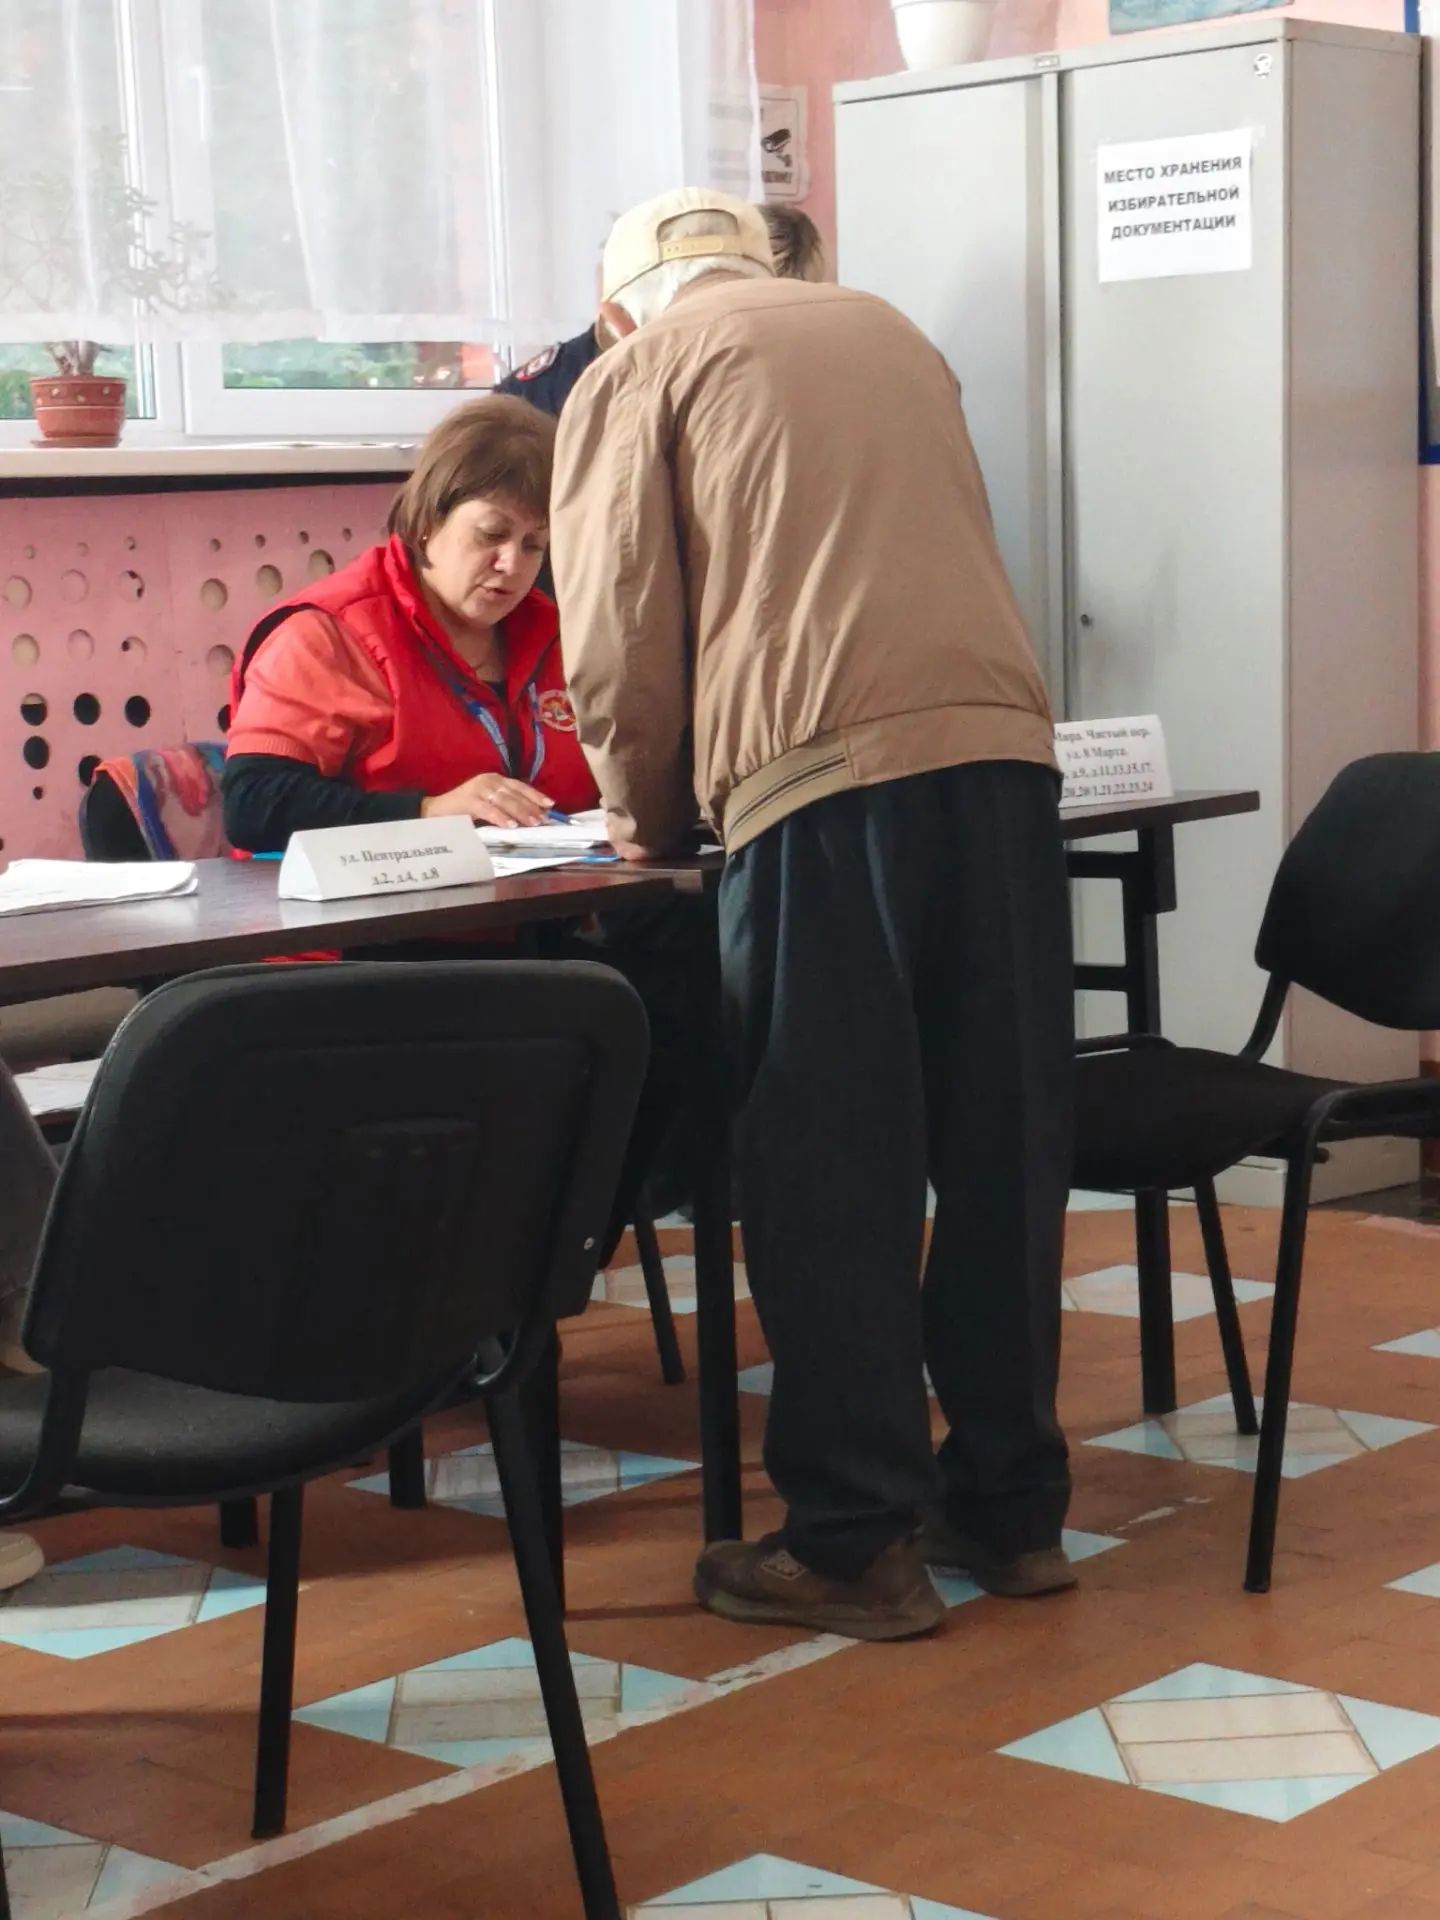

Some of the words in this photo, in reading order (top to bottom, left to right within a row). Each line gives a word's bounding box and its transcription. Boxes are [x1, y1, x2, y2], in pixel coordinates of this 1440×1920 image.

[1103, 167, 1155, 184] МЕСТО
[1160, 156, 1242, 178] ХРАНЕНИЯ
[1108, 185, 1240, 213] ИЗБИРАТЕЛЬНОЙ
[1110, 214, 1237, 241] ДОКУМЕНТАЦИИ
[339, 854, 360, 867] ул.
